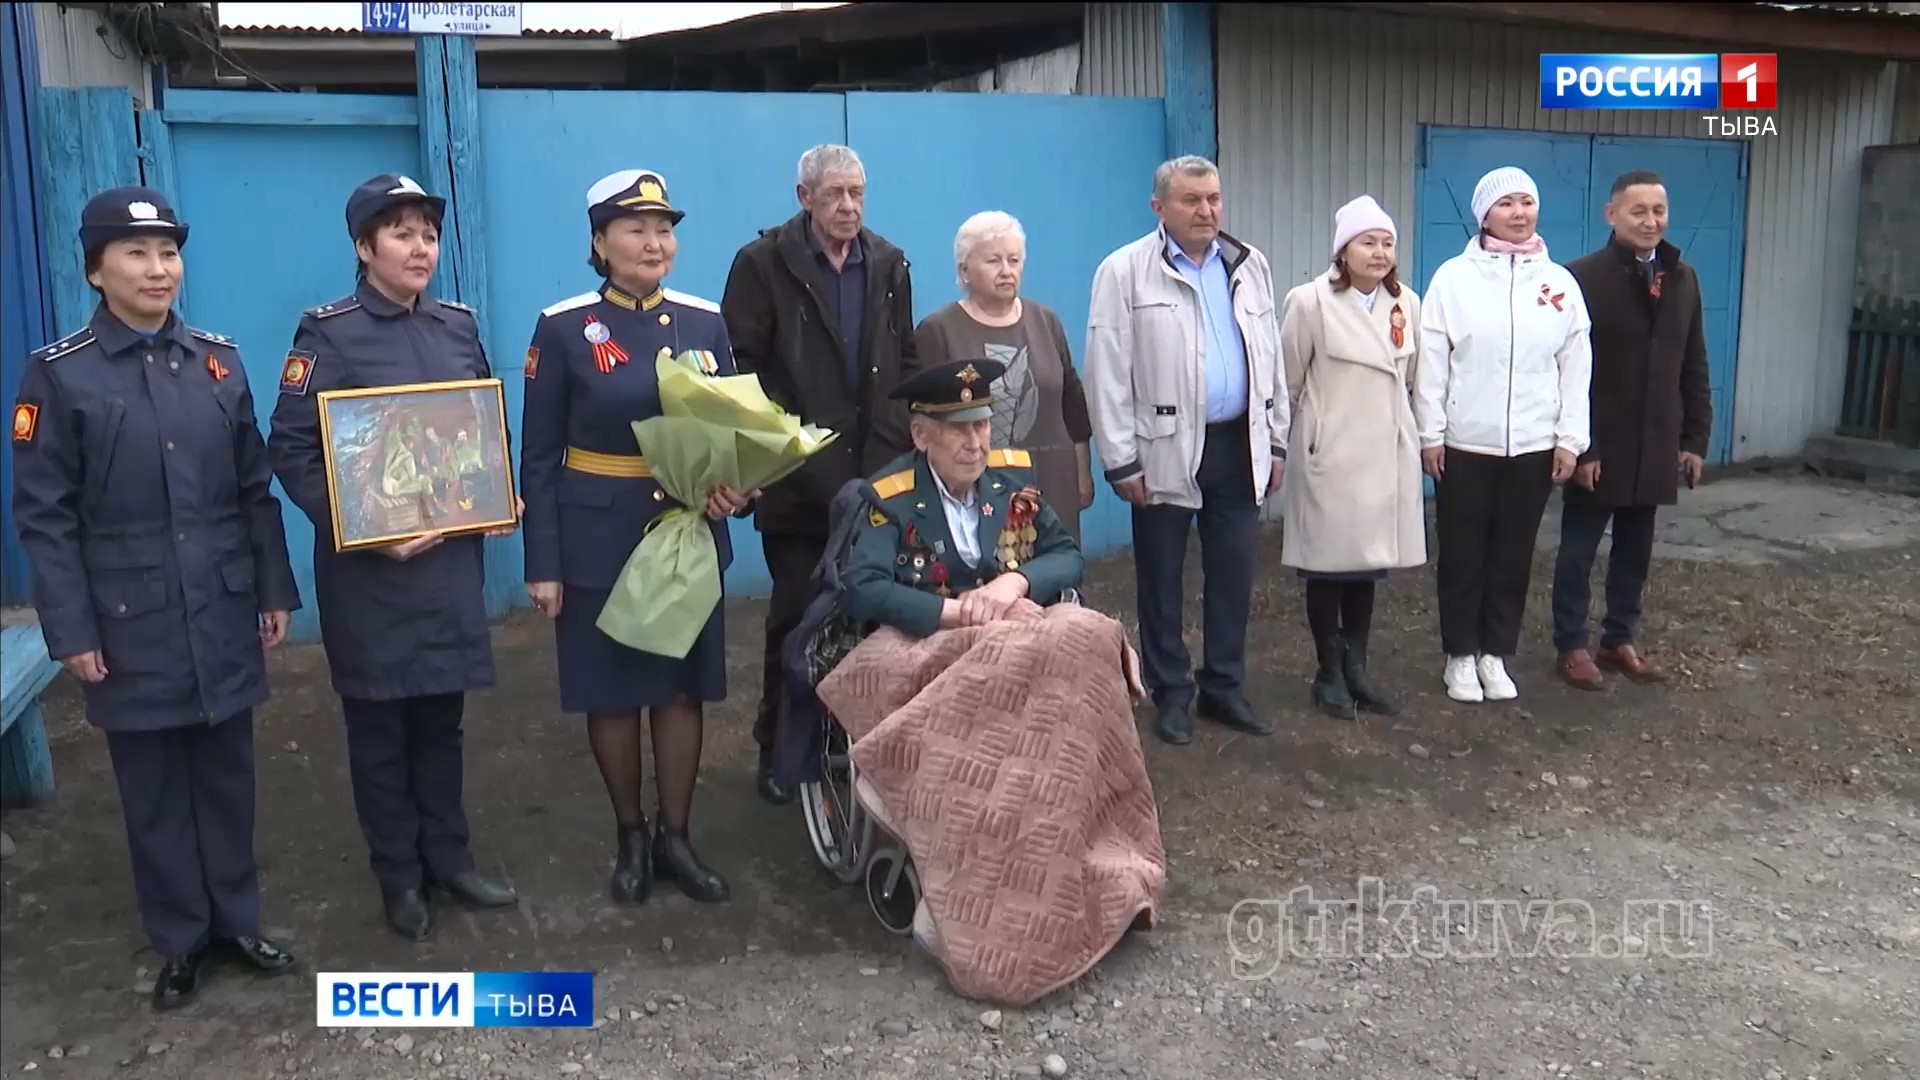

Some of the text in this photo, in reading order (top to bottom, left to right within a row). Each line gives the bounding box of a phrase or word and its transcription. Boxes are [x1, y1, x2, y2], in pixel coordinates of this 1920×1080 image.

[364, 3, 407, 28] 149-2
[412, 3, 516, 21] Пролетарская
[453, 22, 484, 32] улица
